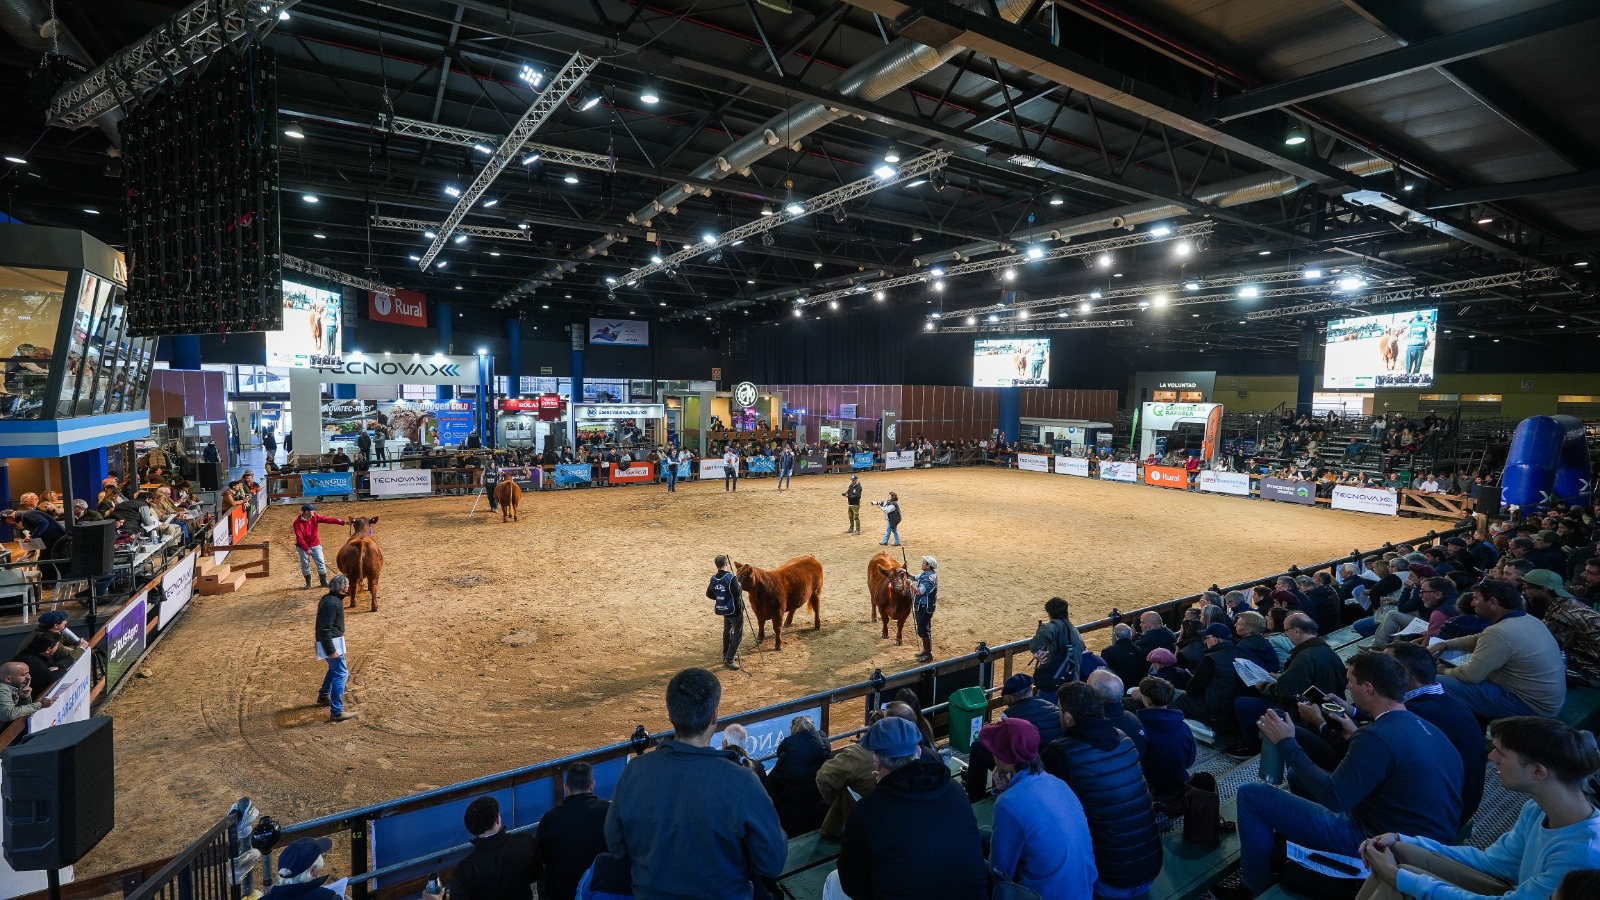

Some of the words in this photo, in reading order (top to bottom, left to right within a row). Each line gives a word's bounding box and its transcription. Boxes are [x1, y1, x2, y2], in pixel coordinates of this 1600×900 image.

[395, 298, 423, 318] Rural
[318, 361, 450, 377] ECNOVAX
[450, 402, 469, 410] GOLD
[319, 478, 347, 486] ANGUS
[372, 476, 424, 484] TECNOVAX
[1162, 473, 1180, 482] Rural
[1266, 483, 1296, 492] Procampo
[1334, 491, 1391, 503] TECNOVAX
